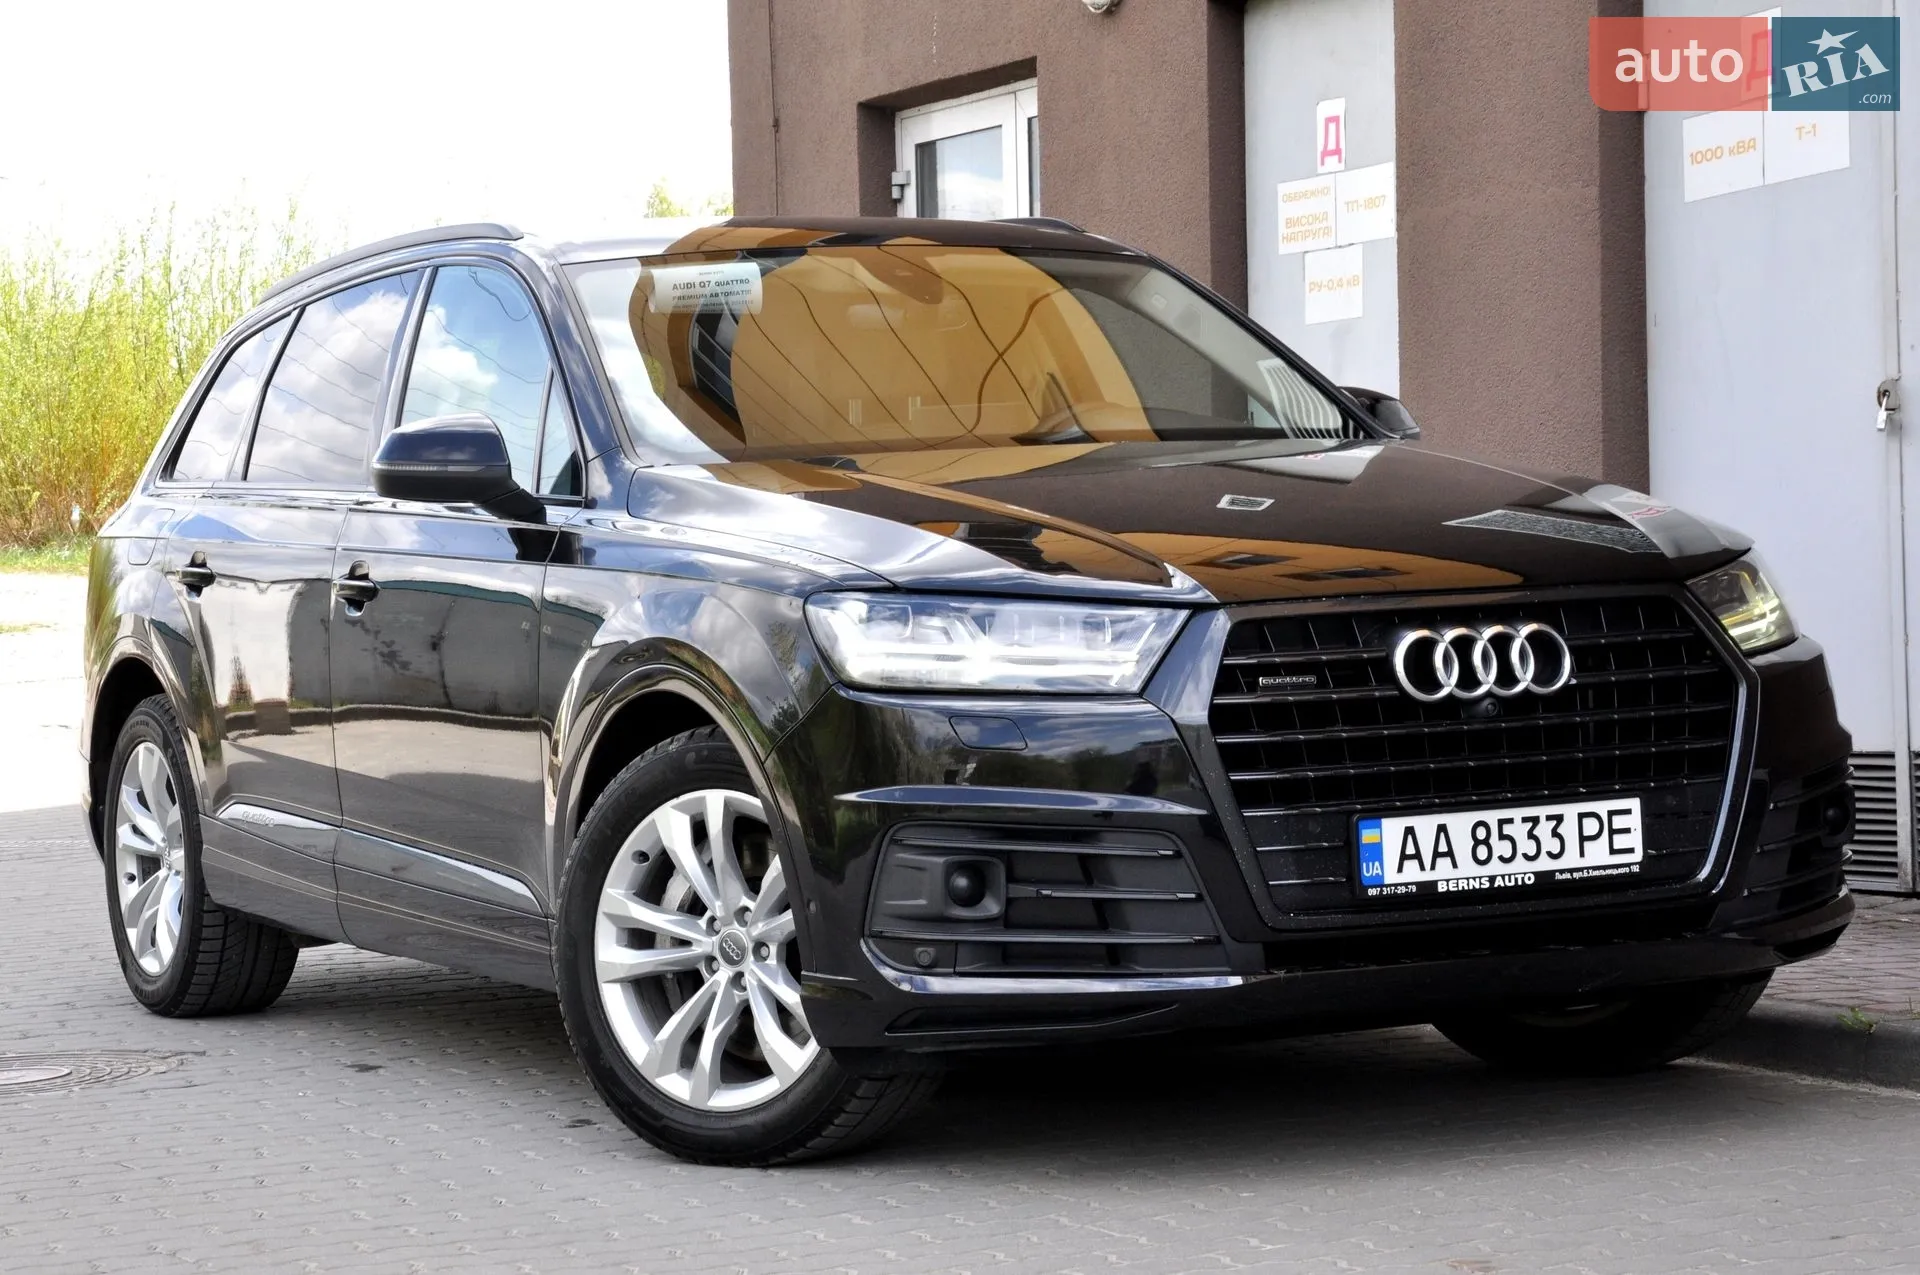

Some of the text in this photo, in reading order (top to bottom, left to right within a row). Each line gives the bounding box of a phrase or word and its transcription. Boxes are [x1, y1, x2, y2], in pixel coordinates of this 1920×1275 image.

[1320, 115, 1342, 166] Д
[1689, 137, 1757, 165] 1000 кВА
[1282, 185, 1331, 204] ОБЕРЕЖНО!
[1344, 195, 1387, 214] ТП-1807
[1285, 211, 1329, 229] ВИСОКА
[1282, 226, 1333, 245] НАПРУГА!
[672, 278, 750, 291] AUDI Q7 QUATTRO
[672, 293, 707, 301] PREMIUM
[1262, 675, 1315, 686] quattro
[1363, 808, 1635, 877] UA AA 8533 PE
[1630, 864, 1640, 873] 192
[1368, 885, 1416, 896] 097 317-29-79
[1437, 873, 1535, 892] BERNS AUTO
